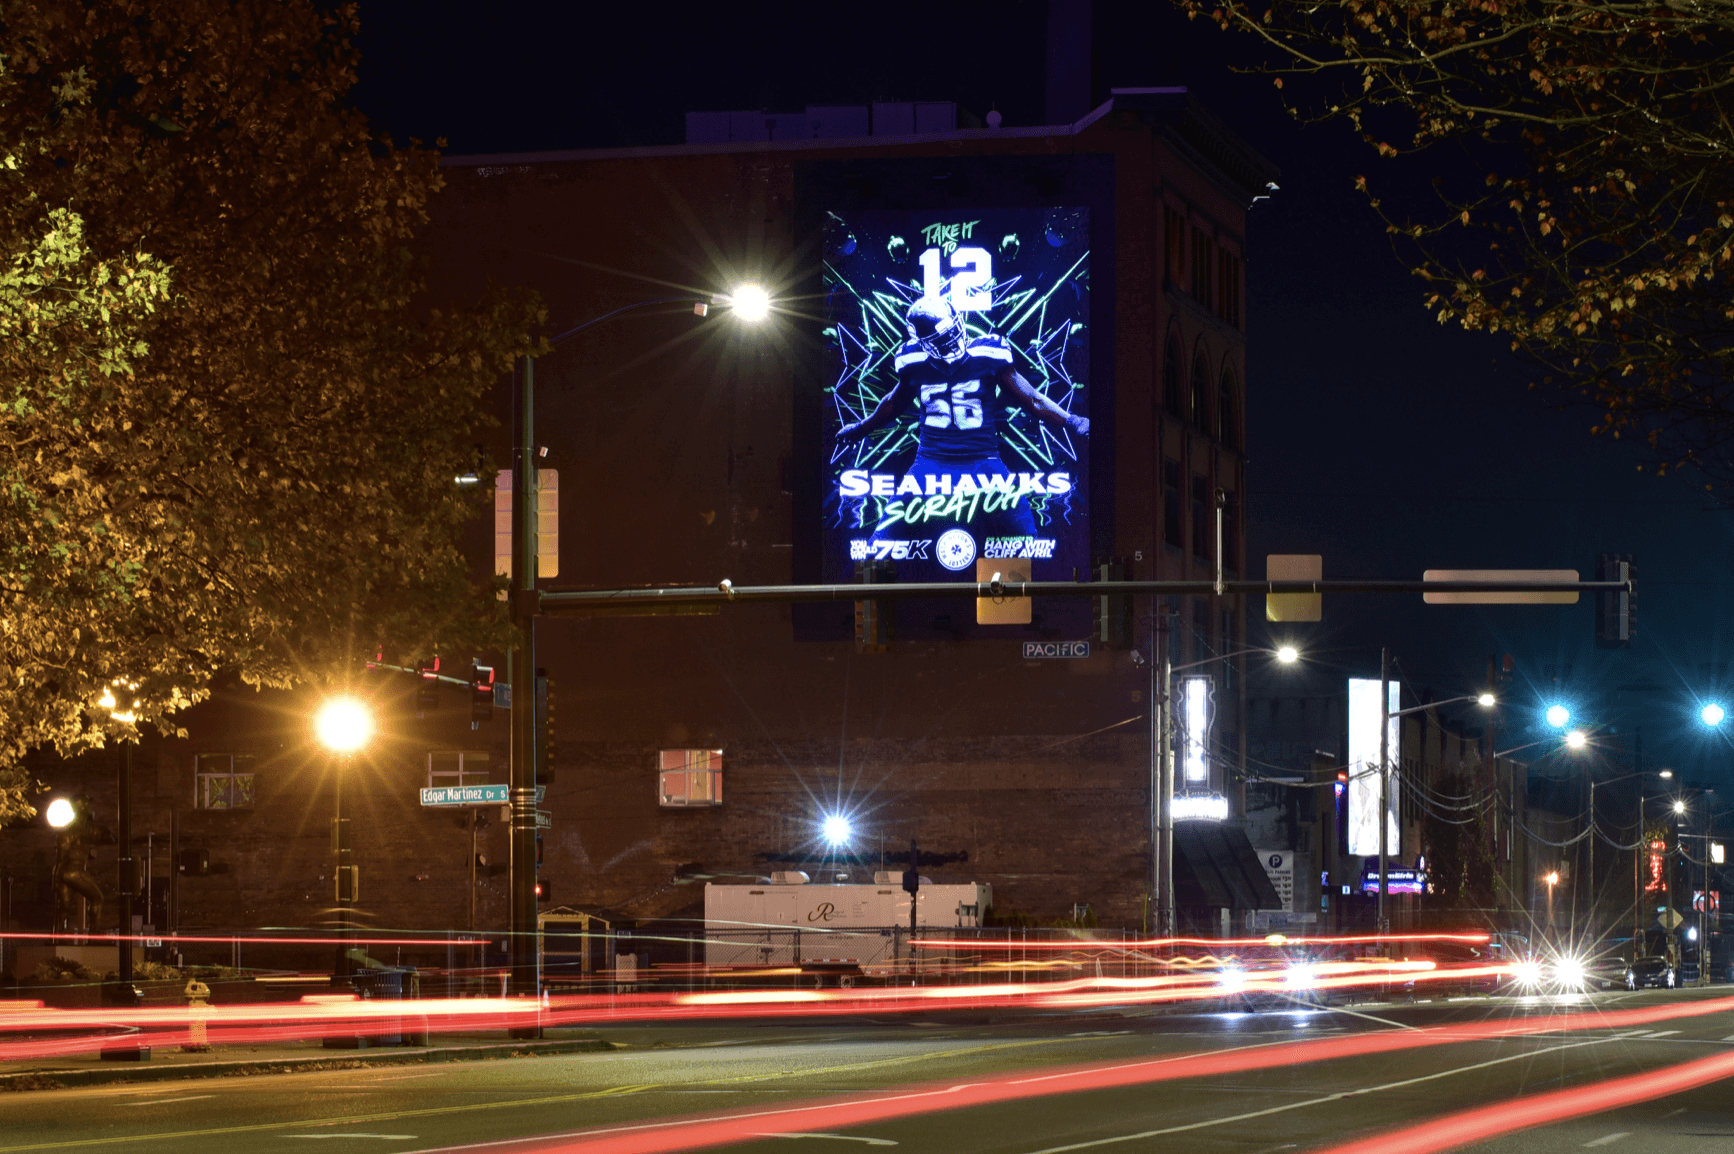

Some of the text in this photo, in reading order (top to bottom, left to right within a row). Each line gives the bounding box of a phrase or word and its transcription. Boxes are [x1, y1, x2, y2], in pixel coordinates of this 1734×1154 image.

[921, 219, 981, 246] TAKE IT
[942, 240, 957, 258] TO
[919, 247, 992, 311] 12
[920, 379, 984, 430] 56
[839, 469, 1072, 497] SEAHAWKS
[875, 485, 1035, 531] SCRATCH
[984, 548, 1053, 558] CLIFF AVRIL
[985, 539, 1056, 550] HANG WITH
[1135, 551, 1143, 561] 5
[1026, 643, 1086, 656] PACIFIC
[422, 788, 506, 803] Edgar Martinez Dr S
